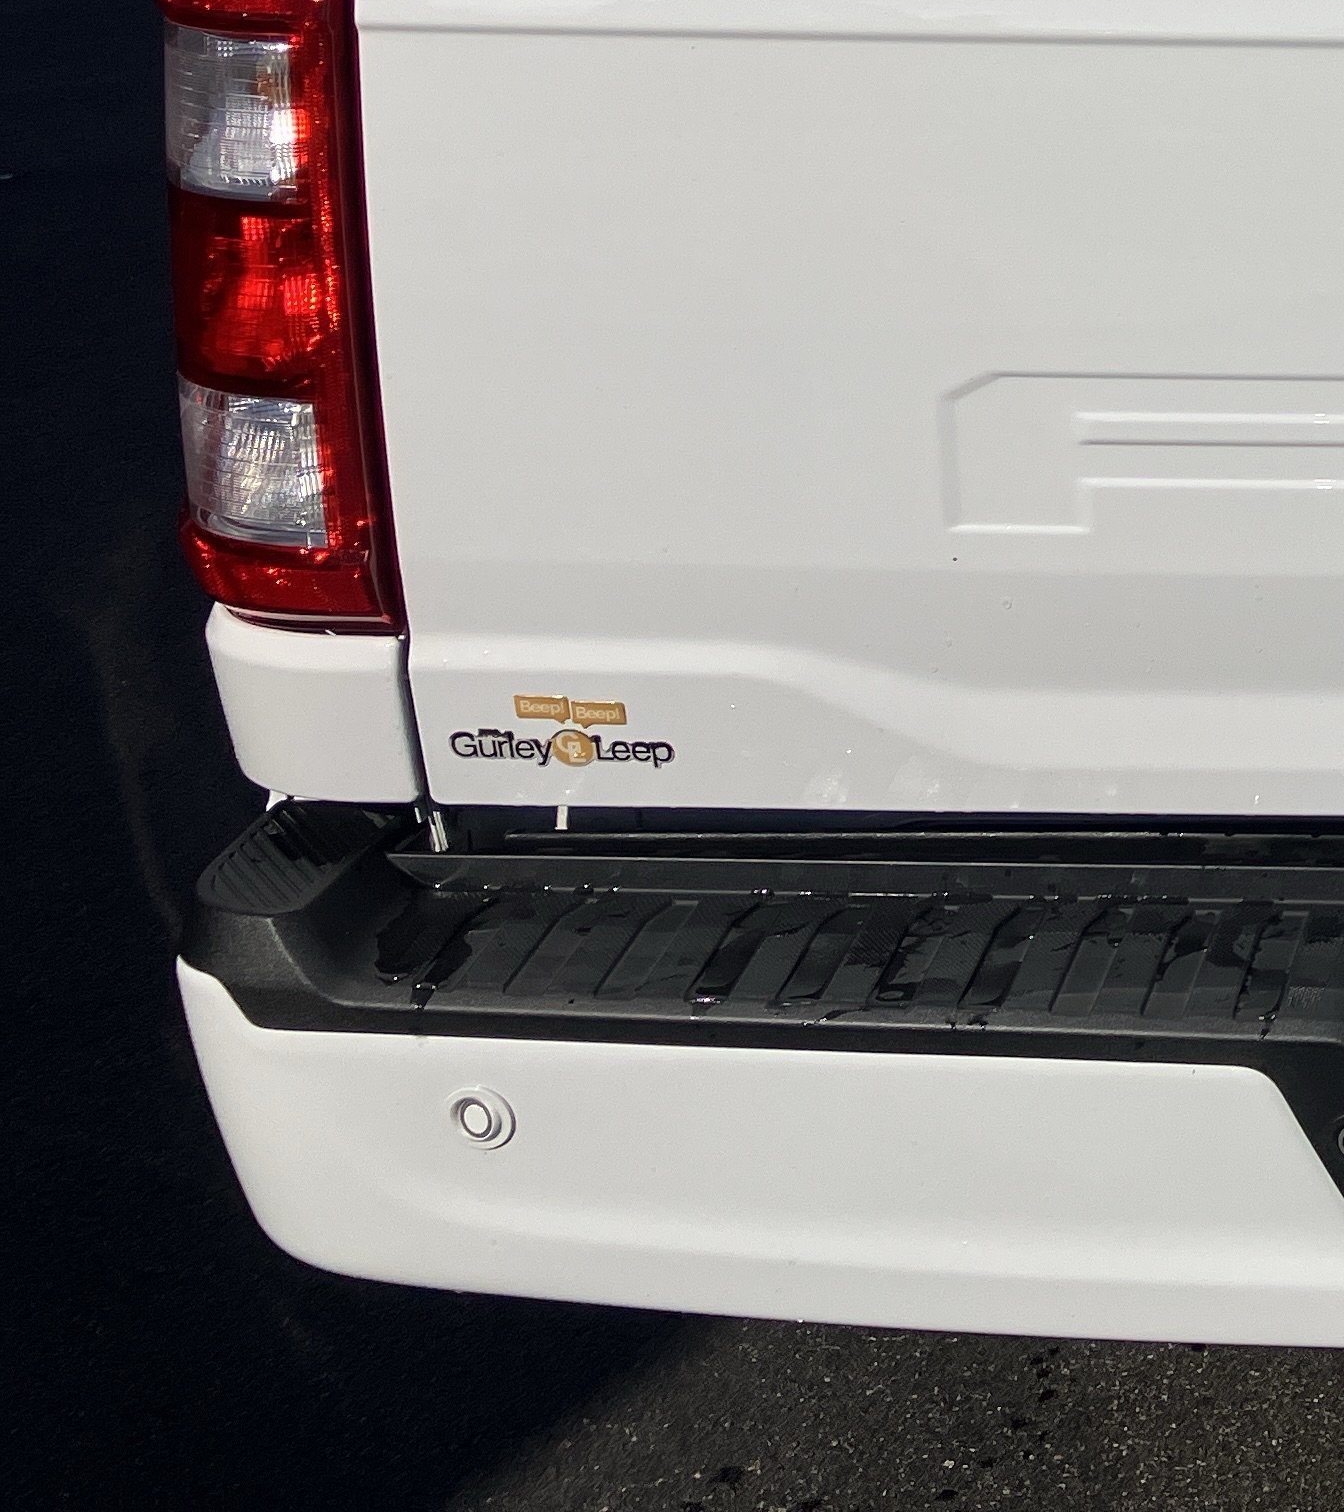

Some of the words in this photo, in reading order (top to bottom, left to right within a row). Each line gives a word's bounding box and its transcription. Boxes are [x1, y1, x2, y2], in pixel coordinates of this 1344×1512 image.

[519, 700, 565, 716] Beep!
[576, 706, 621, 722] Beep!
[594, 735, 676, 768] Leep
